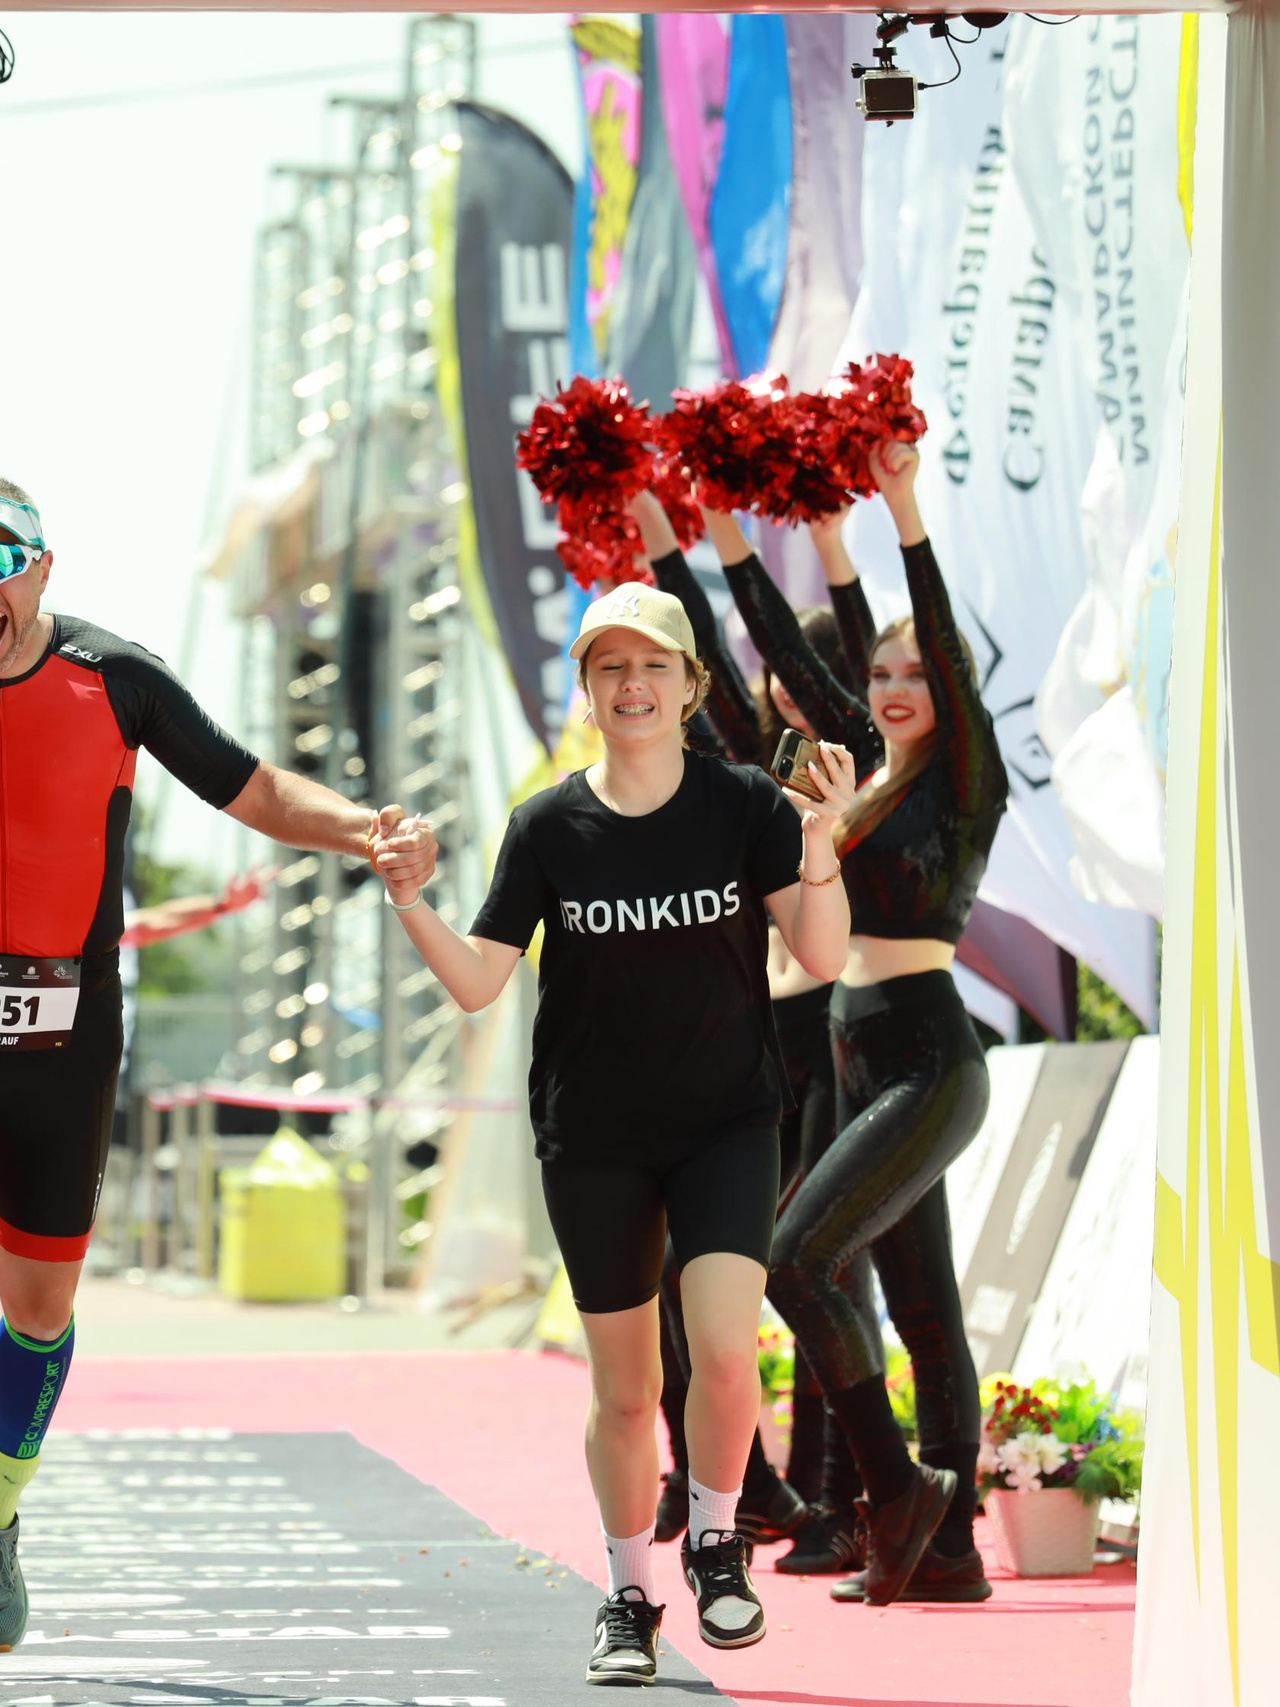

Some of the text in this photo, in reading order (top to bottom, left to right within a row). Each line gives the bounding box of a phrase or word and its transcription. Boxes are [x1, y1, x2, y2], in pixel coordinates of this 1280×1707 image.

[59, 643, 103, 663] 2XU
[559, 880, 741, 935] IRONKIDS
[112, 1625, 451, 1639] STAR
[129, 1695, 508, 1707] STAR
